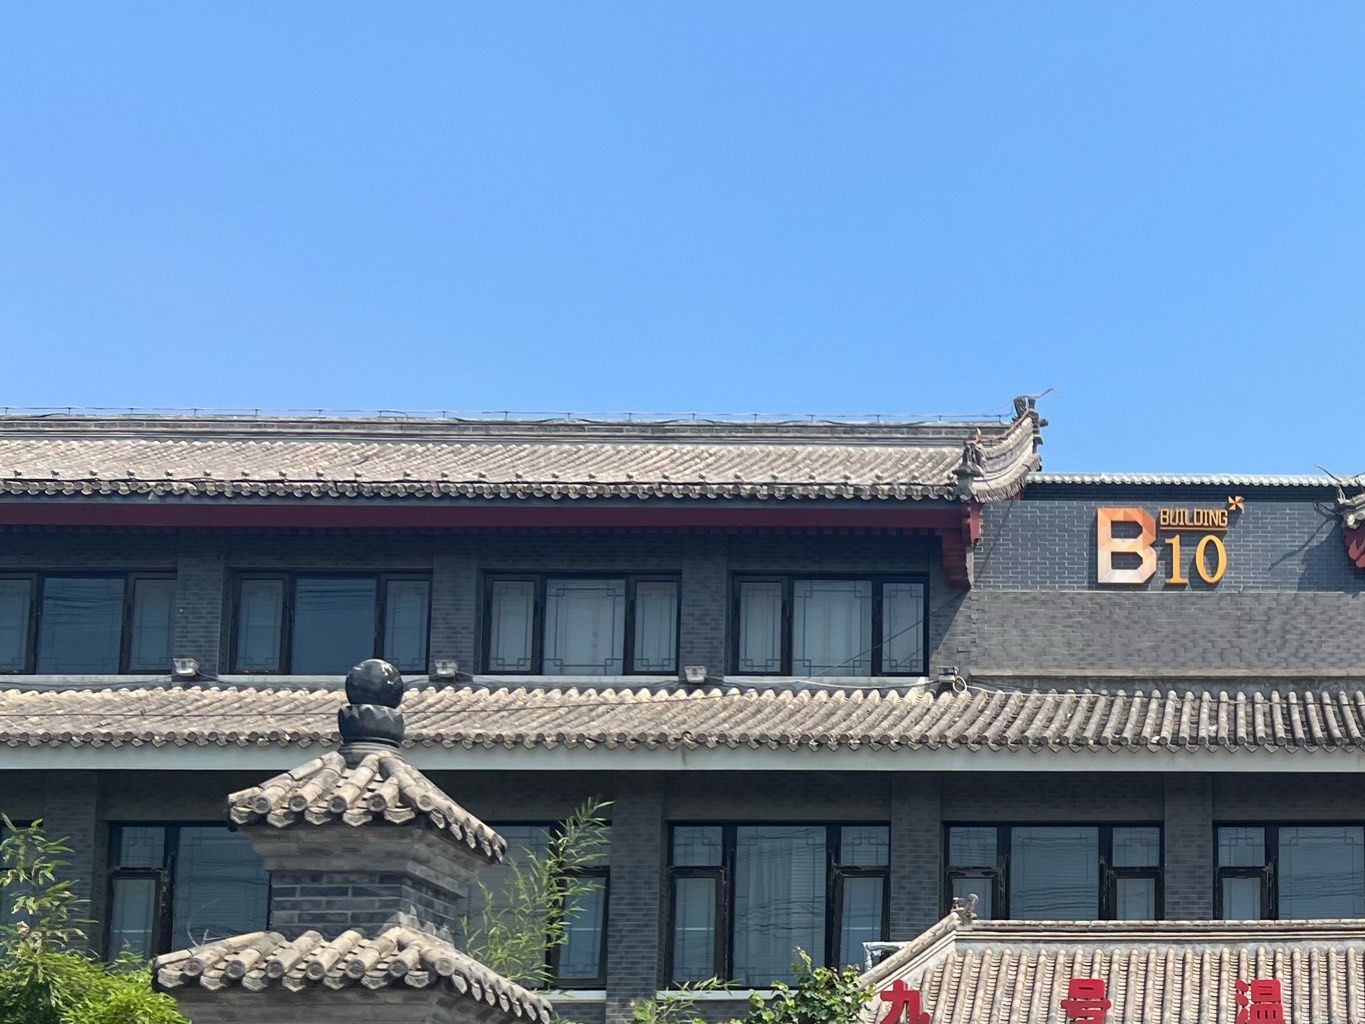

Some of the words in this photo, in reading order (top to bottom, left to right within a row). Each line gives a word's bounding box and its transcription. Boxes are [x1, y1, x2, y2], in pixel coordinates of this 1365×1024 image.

[1159, 508, 1228, 527] BUILDING
[1097, 507, 1157, 584] B
[1165, 534, 1228, 584] 10
